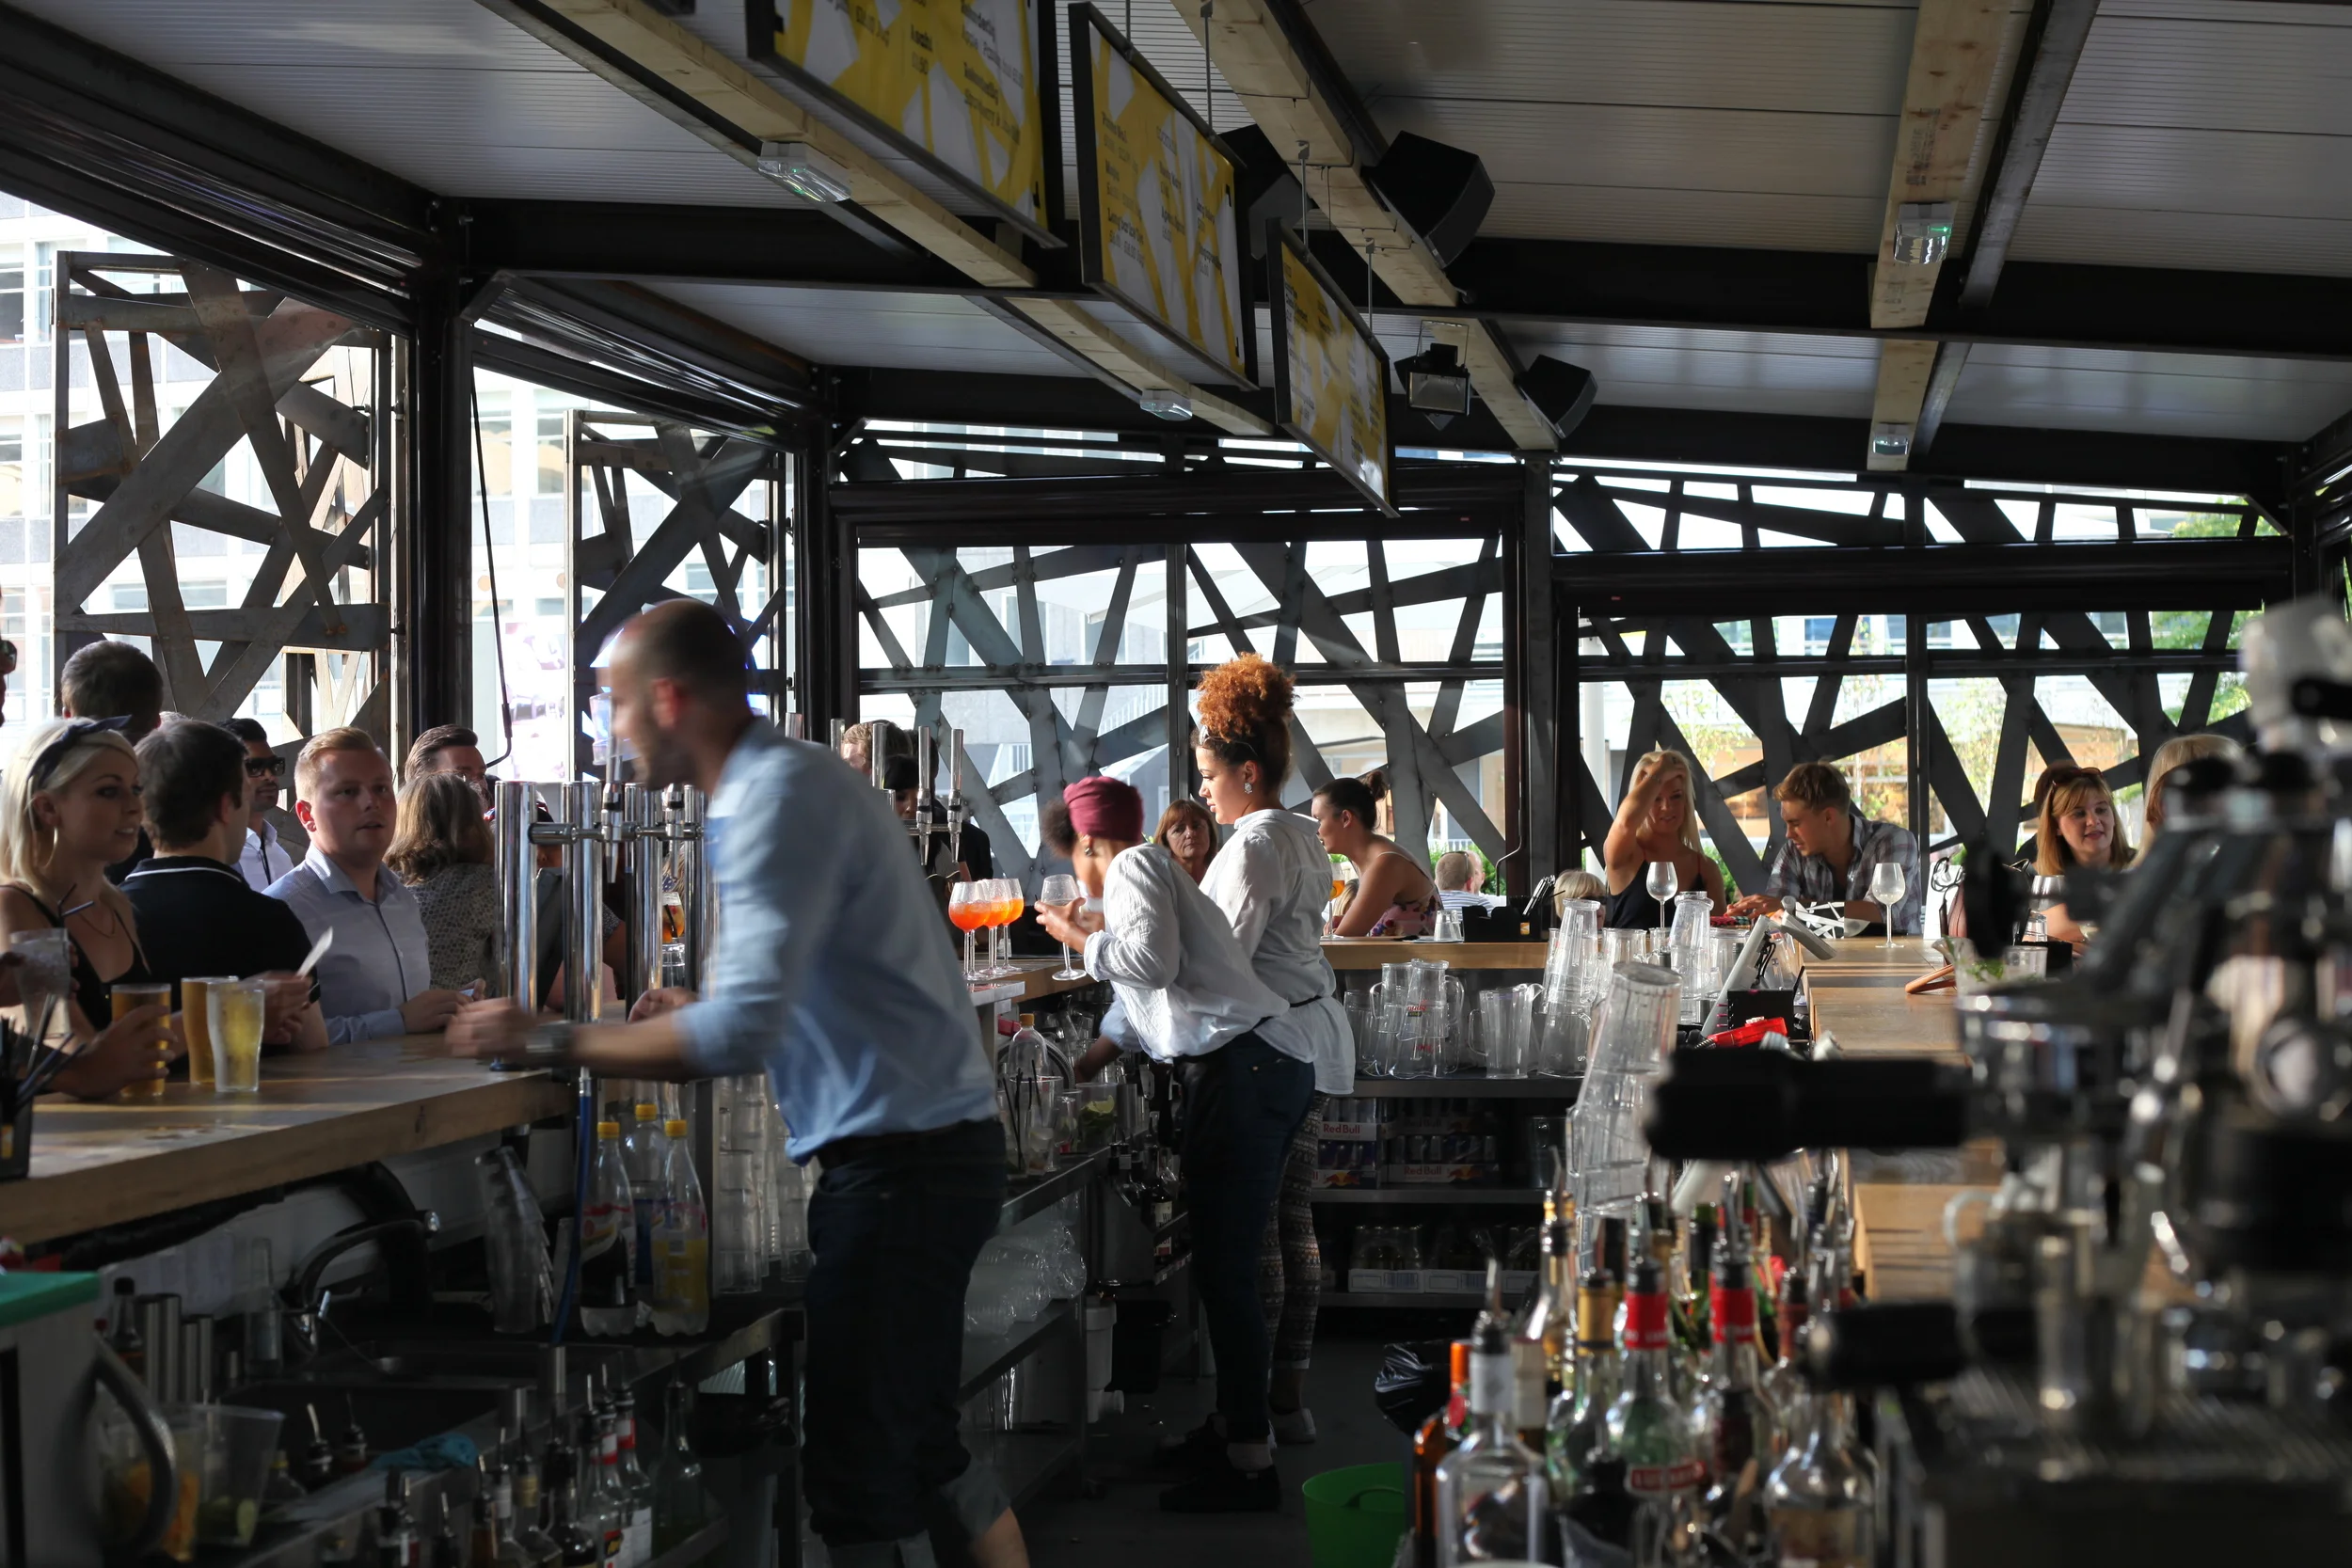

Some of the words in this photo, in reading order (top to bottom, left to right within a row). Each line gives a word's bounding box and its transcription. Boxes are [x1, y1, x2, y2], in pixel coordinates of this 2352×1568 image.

[1324, 1124, 1342, 1134] Red
[1343, 1124, 1360, 1134] Bull
[1404, 1165, 1422, 1175] Red
[1423, 1165, 1441, 1176] Bull
